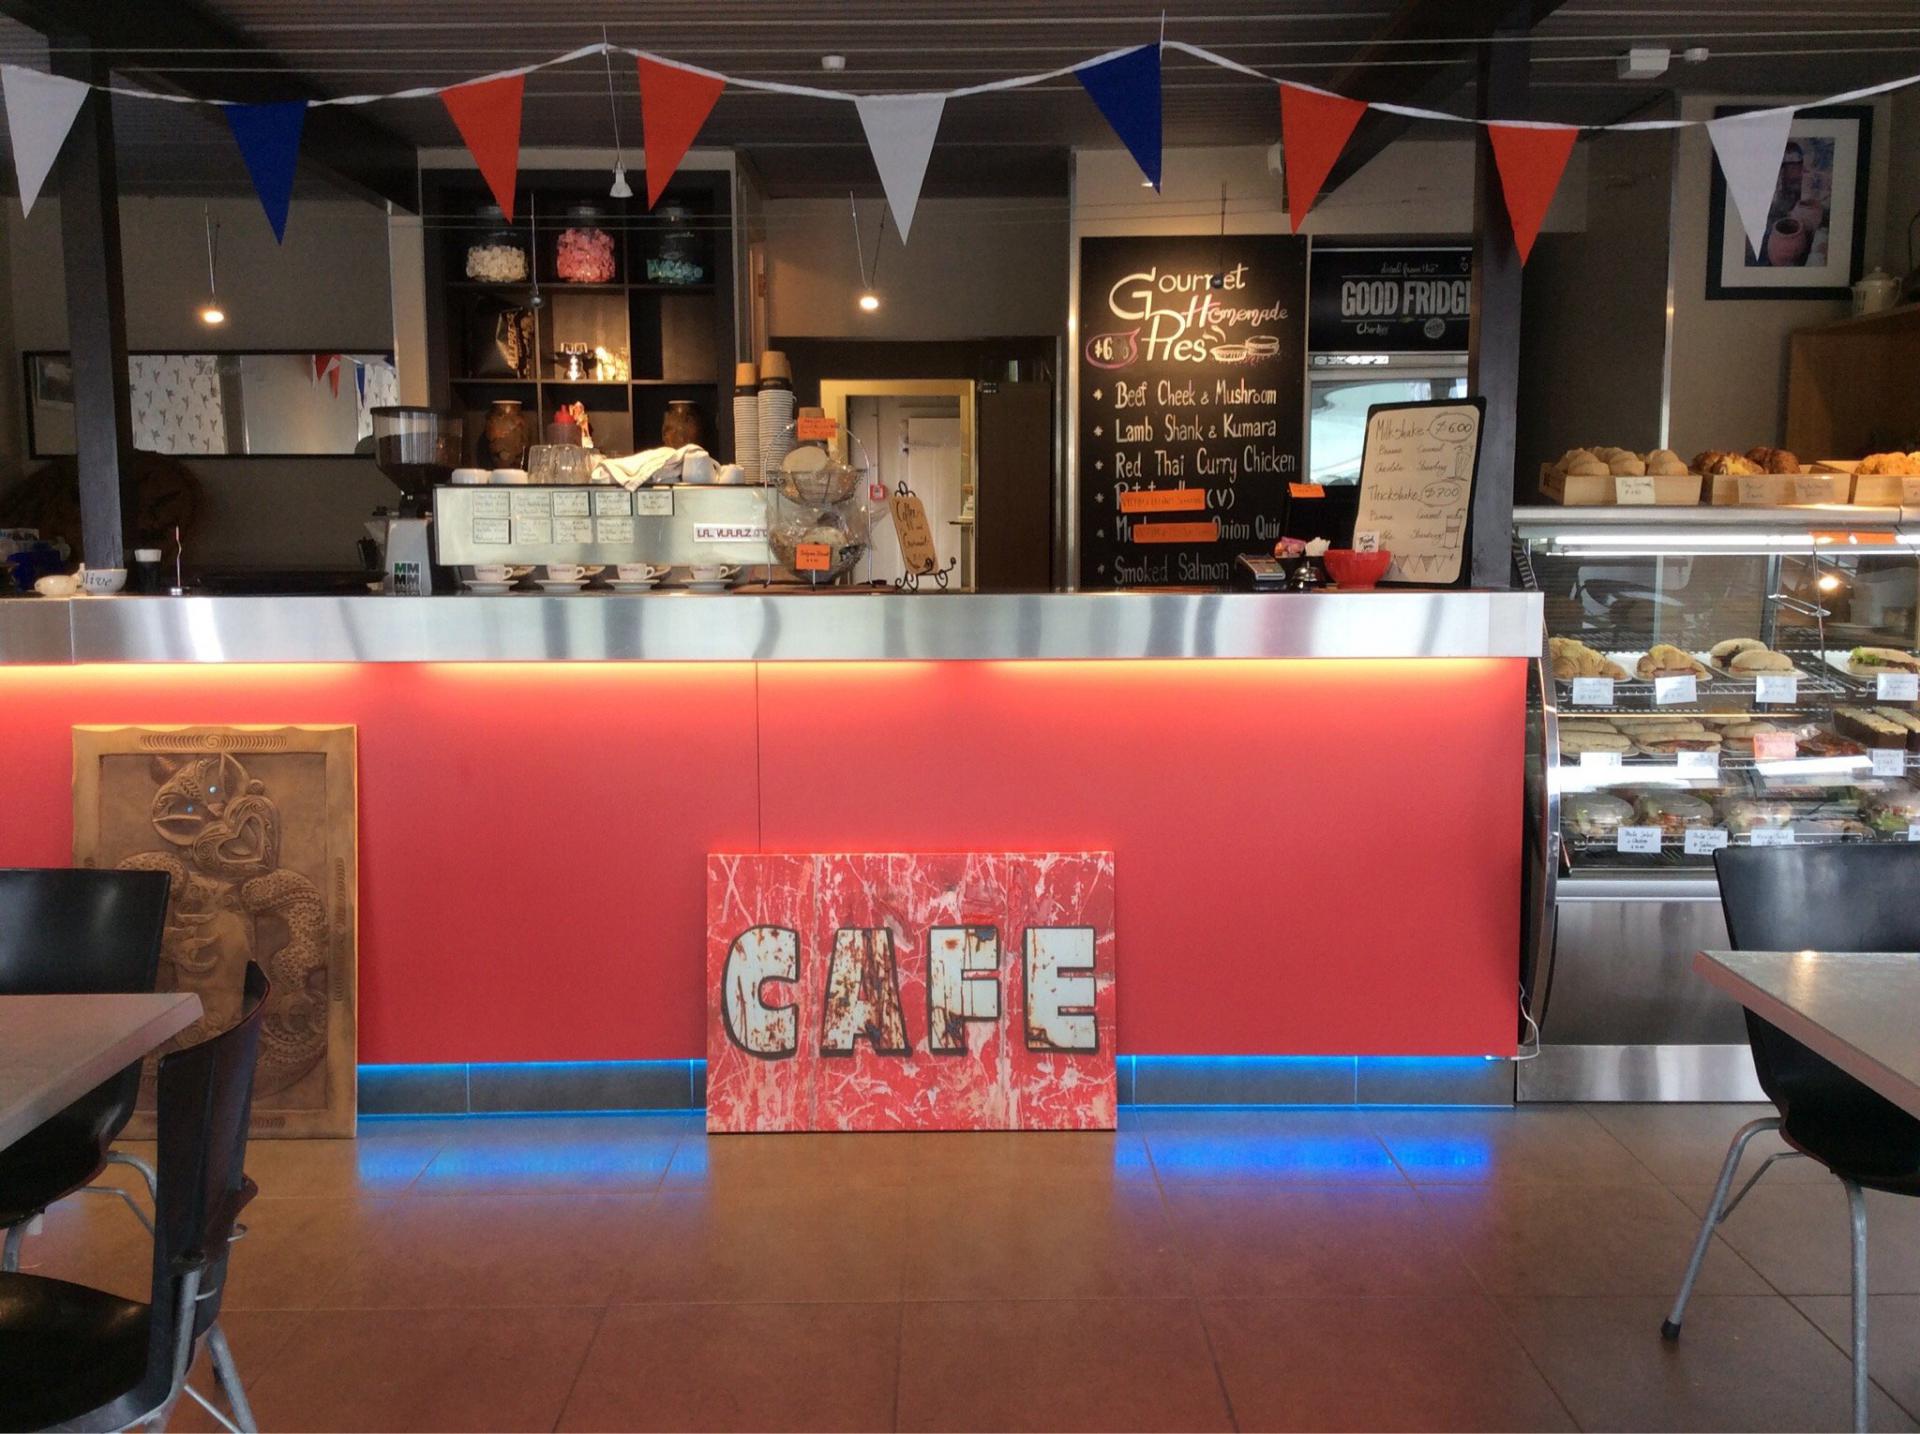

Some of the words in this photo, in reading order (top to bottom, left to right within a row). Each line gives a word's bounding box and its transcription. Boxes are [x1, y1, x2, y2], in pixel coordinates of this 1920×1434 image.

[1184, 293, 1288, 328] Homemade
[1341, 281, 1398, 316] GOOD
[1141, 309, 1207, 362] Pies
[1115, 381, 1148, 408] Beef
[1157, 380, 1196, 406] Cheek
[1200, 393, 1209, 405] &
[1215, 377, 1277, 406] Mushroom
[1115, 416, 1153, 443] Lamb
[1164, 413, 1204, 442] Shank
[1208, 425, 1217, 438] &
[1223, 413, 1277, 438] Kumara
[1115, 452, 1142, 478] Red
[1154, 450, 1185, 476] Thai
[1196, 447, 1238, 484] Curry
[1243, 445, 1295, 473] Chicken
[1114, 555, 1169, 585] Smoked
[1178, 552, 1230, 582] Salmon
[720, 924, 1099, 1059] CAFE
